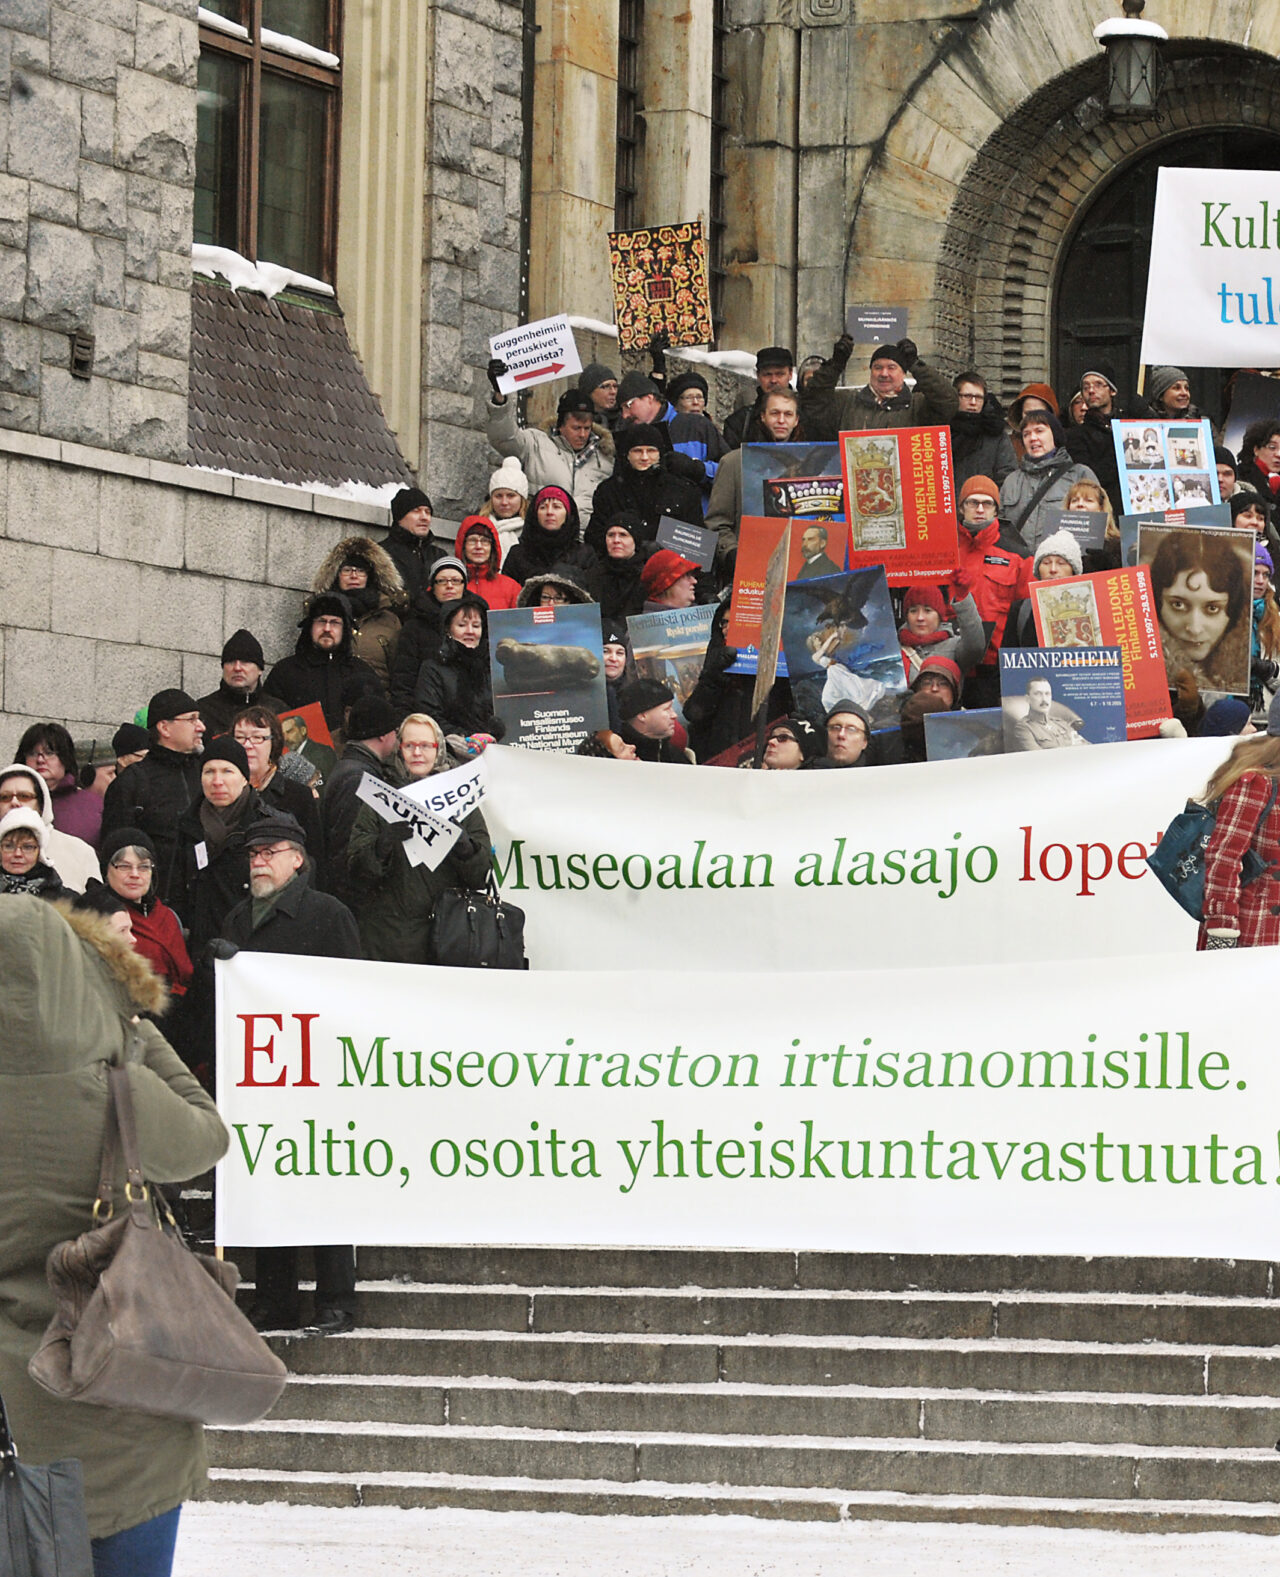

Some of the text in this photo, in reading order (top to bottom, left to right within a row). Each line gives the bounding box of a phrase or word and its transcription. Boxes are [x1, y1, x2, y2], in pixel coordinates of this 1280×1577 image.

[493, 322, 567, 351] Guggenheimiin
[505, 337, 559, 360] peruskivet
[507, 347, 565, 371] naapurista?
[922, 432, 938, 514] Finlands lejon
[914, 487, 929, 541] SUOMEN
[1120, 573, 1143, 661] Finlands lejon
[1002, 650, 1120, 669] MANNERHEIM
[533, 709, 570, 719] Suomen
[534, 723, 571, 734] Finlands
[518, 730, 588, 742] nationalmuseum
[372, 791, 441, 848] AUKI
[493, 840, 775, 890] Museoalan
[795, 832, 998, 899] alasajo
[235, 1013, 1248, 1091] EI Museoviraston irtisanomisille.
[232, 1119, 410, 1188] Valtio,
[430, 1120, 602, 1178] osoita
